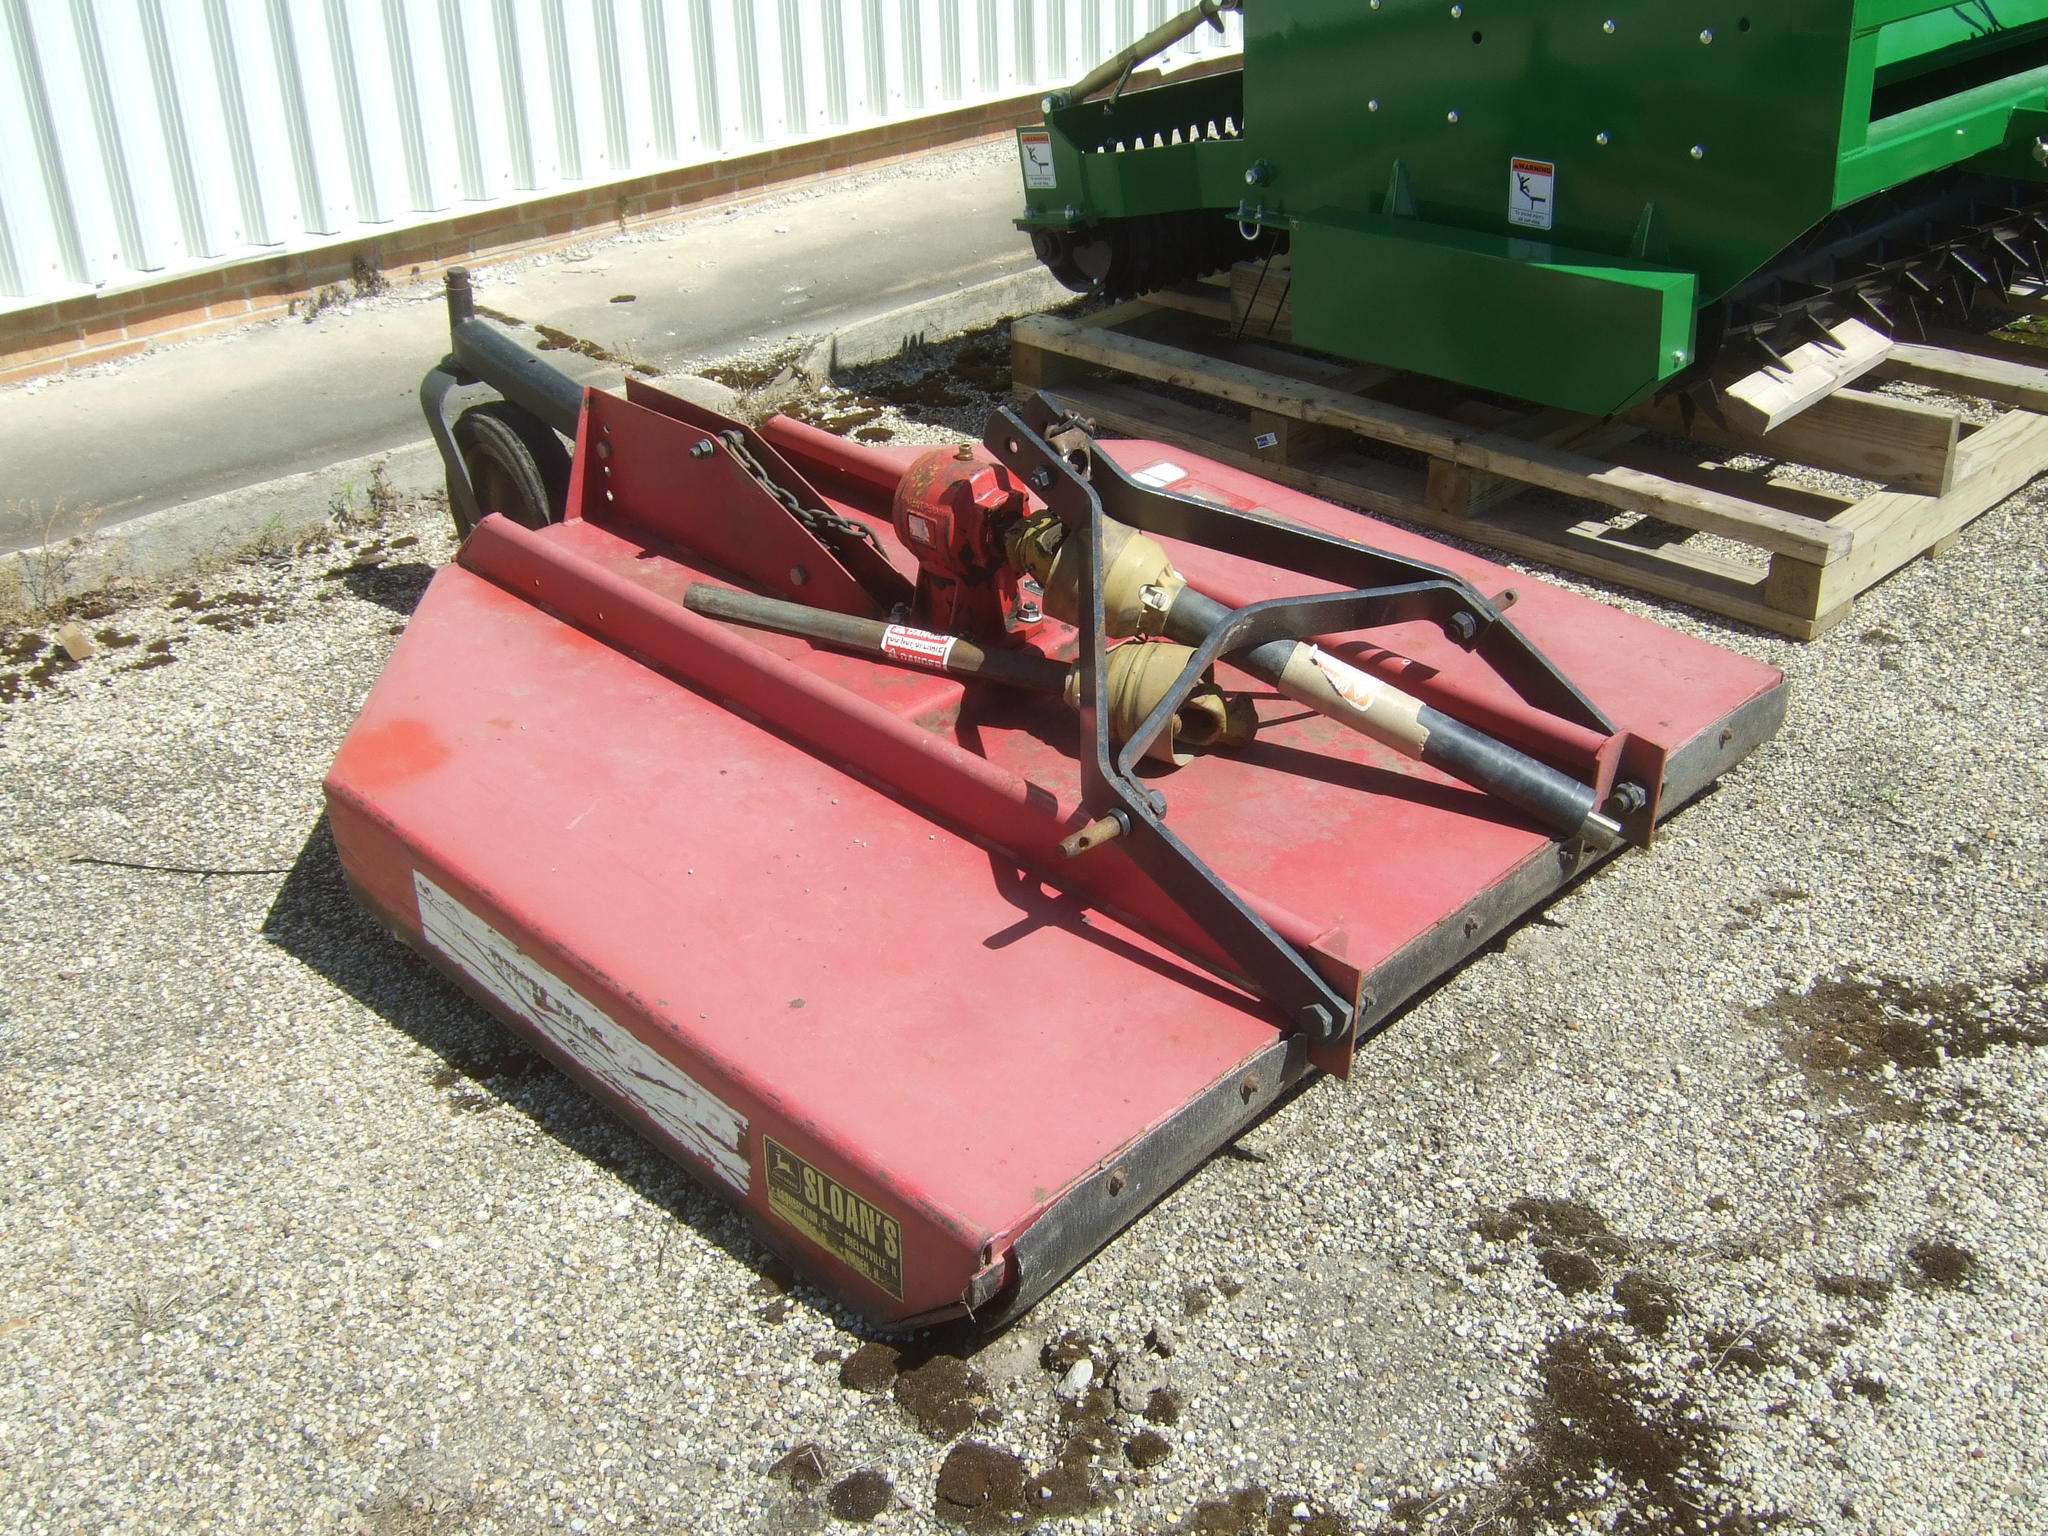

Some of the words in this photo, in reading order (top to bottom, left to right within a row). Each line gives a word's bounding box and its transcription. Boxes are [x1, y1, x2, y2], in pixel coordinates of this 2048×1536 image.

[1518, 162, 1552, 173] WARNING
[900, 652, 942, 667] DANGER
[803, 1166, 898, 1259] SLOAN'S
